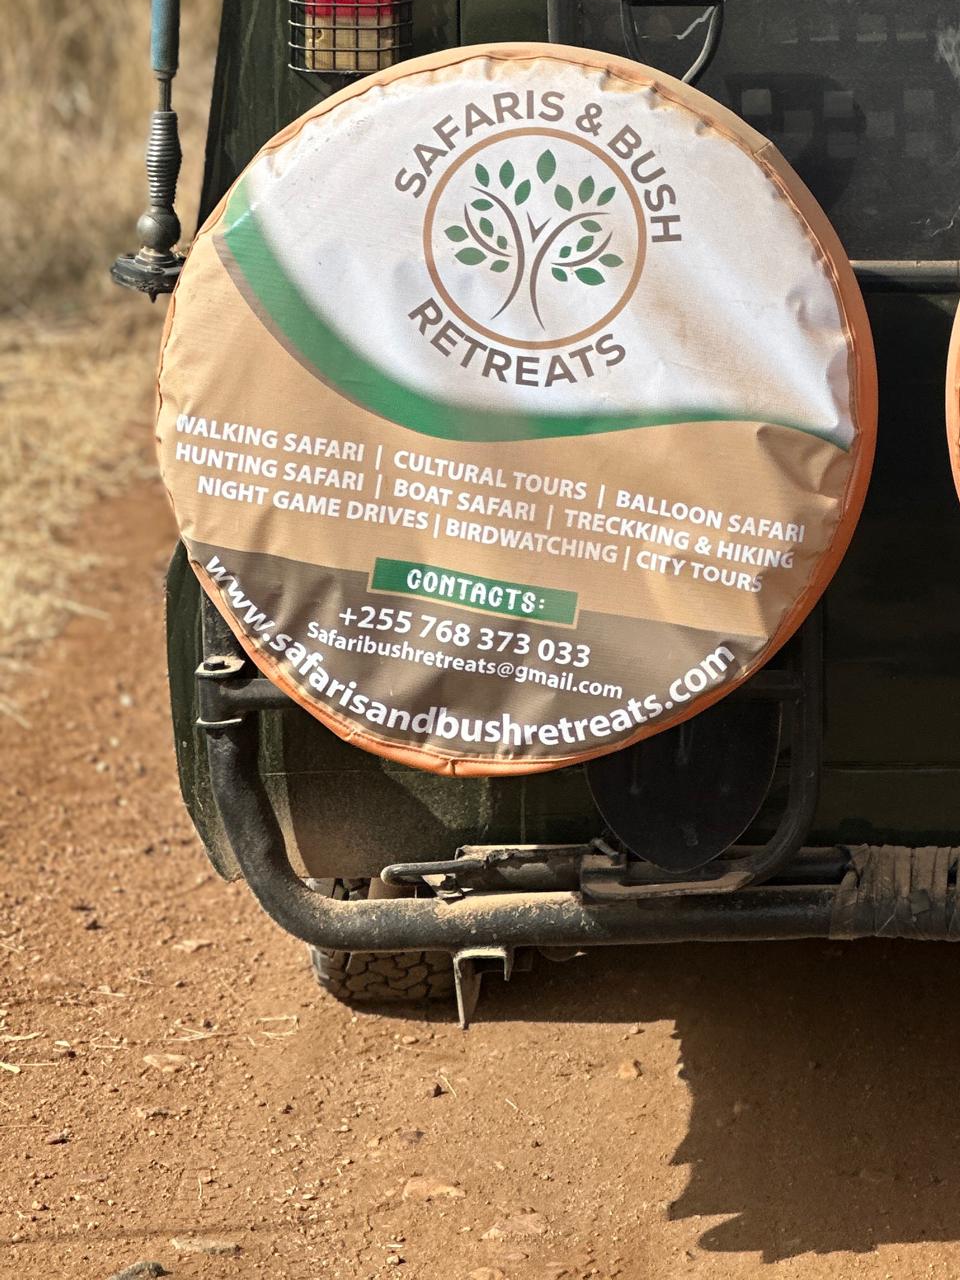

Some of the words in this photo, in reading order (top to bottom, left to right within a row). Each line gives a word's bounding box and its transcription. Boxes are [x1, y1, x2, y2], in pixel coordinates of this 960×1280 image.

[394, 89, 566, 199] SAFARIS
[575, 103, 603, 137] &
[607, 124, 683, 243] BUSH
[407, 297, 627, 388] RETREATS
[175, 413, 278, 449] WALKING
[283, 432, 365, 462] SAFARI
[393, 450, 507, 488] CULTURAL
[513, 471, 587, 500] TOURS
[615, 490, 723, 529] BALLOON
[727, 514, 806, 543] SAFARI
[175, 441, 278, 478] HUNTING
[283, 462, 364, 491] SAFARI
[393, 479, 453, 507] BOAT
[457, 493, 536, 521] SAFARI
[564, 508, 691, 548] TRECKKING
[694, 536, 712, 556] &
[717, 542, 794, 569] HIKING
[197, 475, 269, 506] NIGHT
[272, 490, 341, 518] GAME
[346, 500, 429, 530] DRIVES
[445, 518, 618, 564] BIRDWATCHING
[636, 550, 686, 577] CITY
[690, 561, 763, 593] TOURS
[338, 605, 413, 634] +255
[419, 615, 471, 647] 768
[476, 627, 531, 655] 373
[537, 638, 591, 668] 033
[406, 569, 545, 613] CONTACTS:
[204, 555, 735, 746] www.safarisandbushretreats.com
[306, 621, 623, 700] Safaribushretreats@gmail.com
